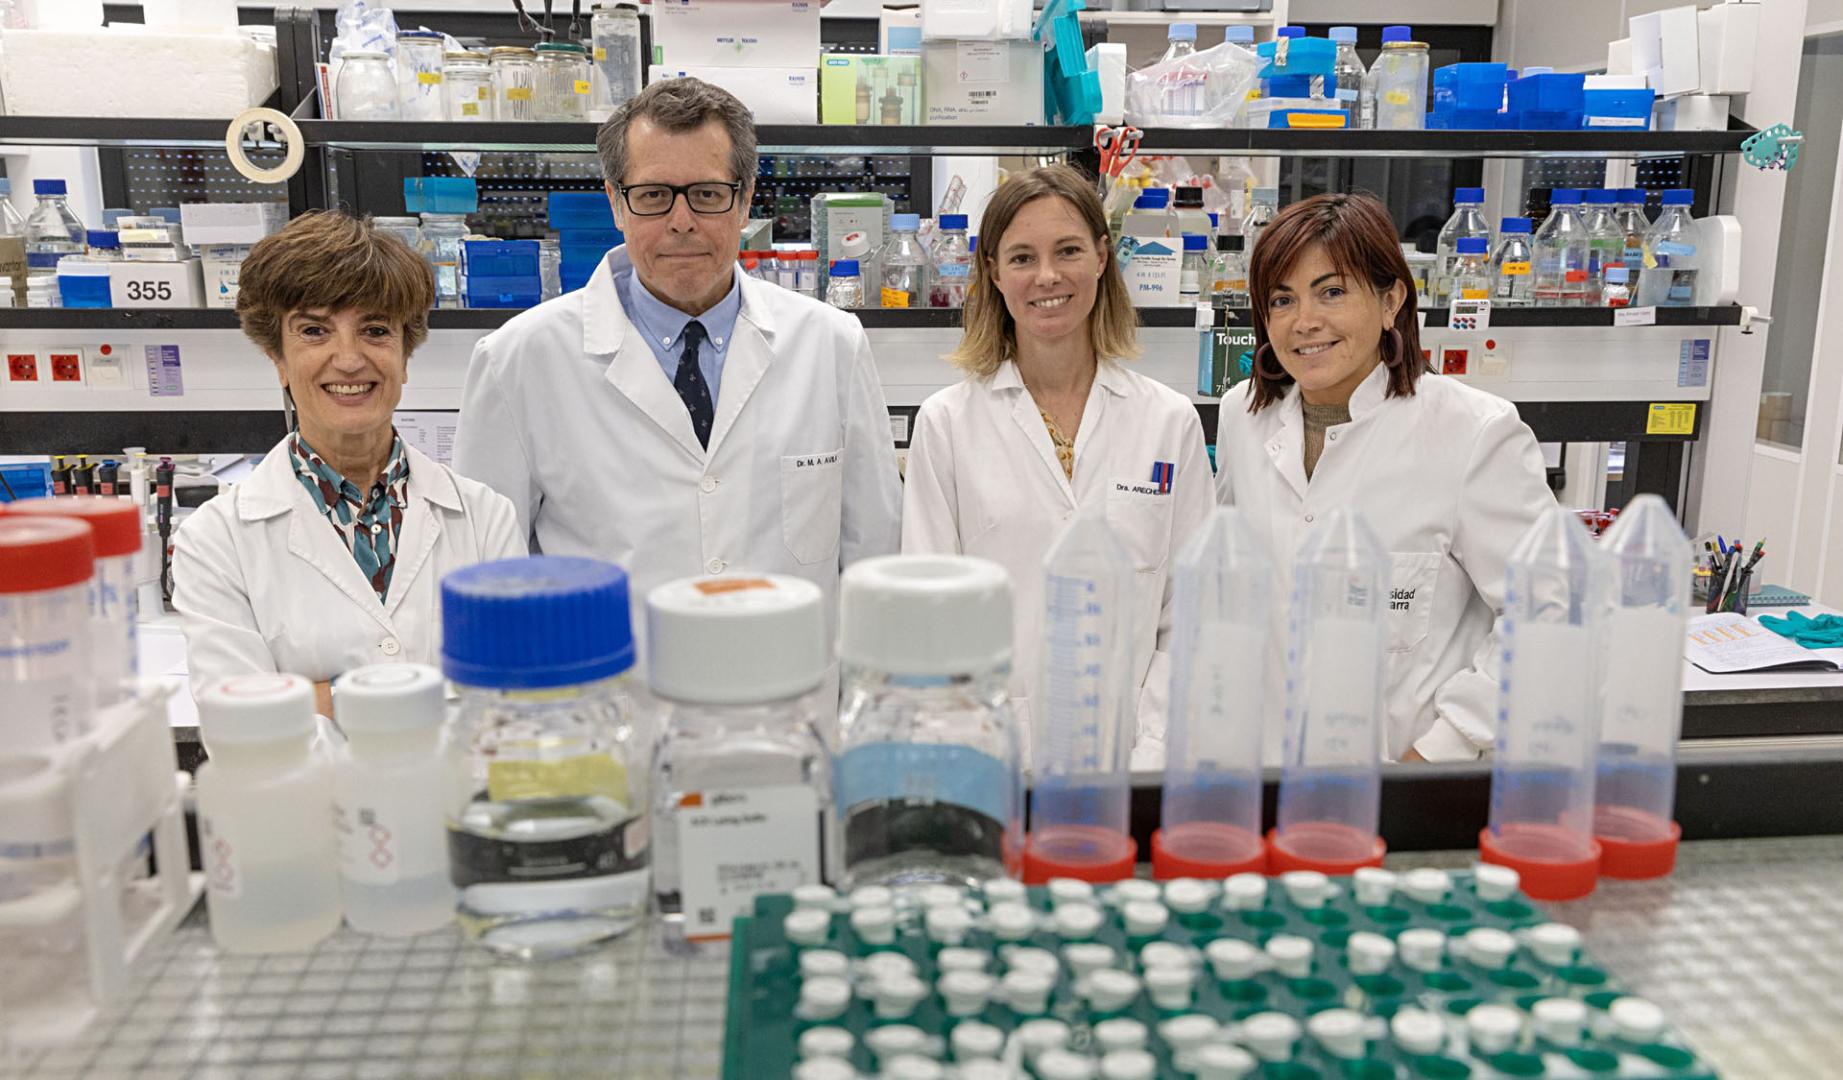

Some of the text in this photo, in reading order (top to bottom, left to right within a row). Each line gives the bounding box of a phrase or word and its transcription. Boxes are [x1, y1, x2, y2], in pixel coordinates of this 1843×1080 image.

[127, 281, 172, 300] 355
[1216, 332, 1256, 345] Touch
[1389, 588, 1416, 600] sidad
[1389, 601, 1410, 610] arra
